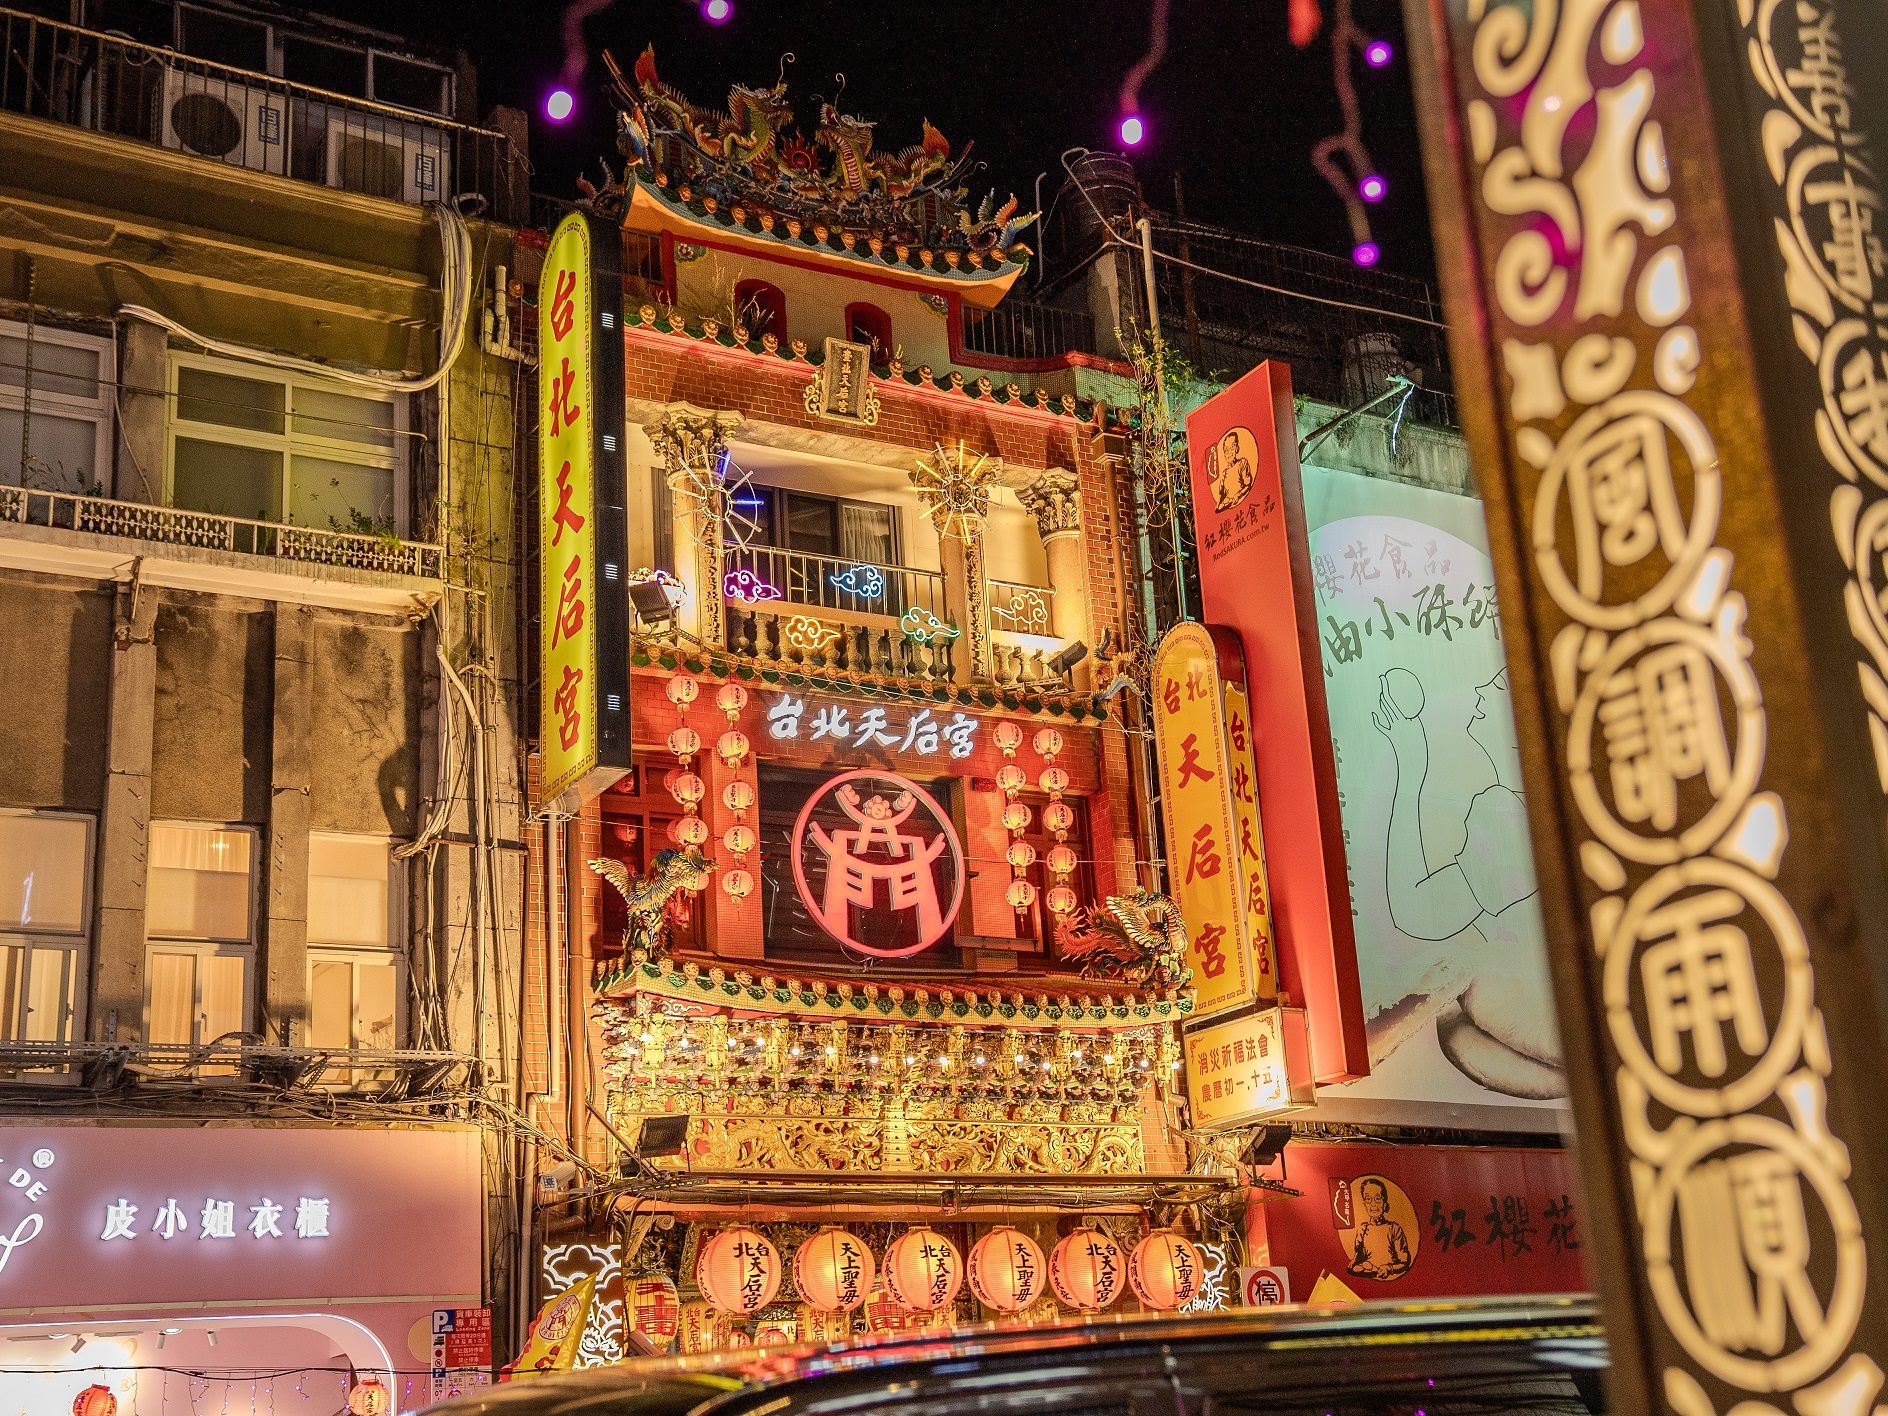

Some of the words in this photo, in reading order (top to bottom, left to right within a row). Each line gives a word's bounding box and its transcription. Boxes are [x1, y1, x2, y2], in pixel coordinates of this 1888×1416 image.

[550, 269, 584, 753] 台北天后宮
[766, 693, 979, 759] 台北天后宮
[1163, 671, 1227, 980] 台北天后宮
[1230, 710, 1270, 975] 台北天后宮
[1197, 1034, 1269, 1076] 消災祈福法會
[100, 1197, 331, 1241] 皮小姐衣櫃
[733, 1242, 770, 1309] 台北天后宮
[836, 1242, 861, 1305] 天上聖母
[919, 1244, 951, 1305] 台北天后宮
[1012, 1243, 1035, 1303] 天上聖母
[1086, 1243, 1118, 1303] 台北天后宮
[1174, 1244, 1195, 1300] 天上聖母
[1254, 1280, 1280, 1306] 停
